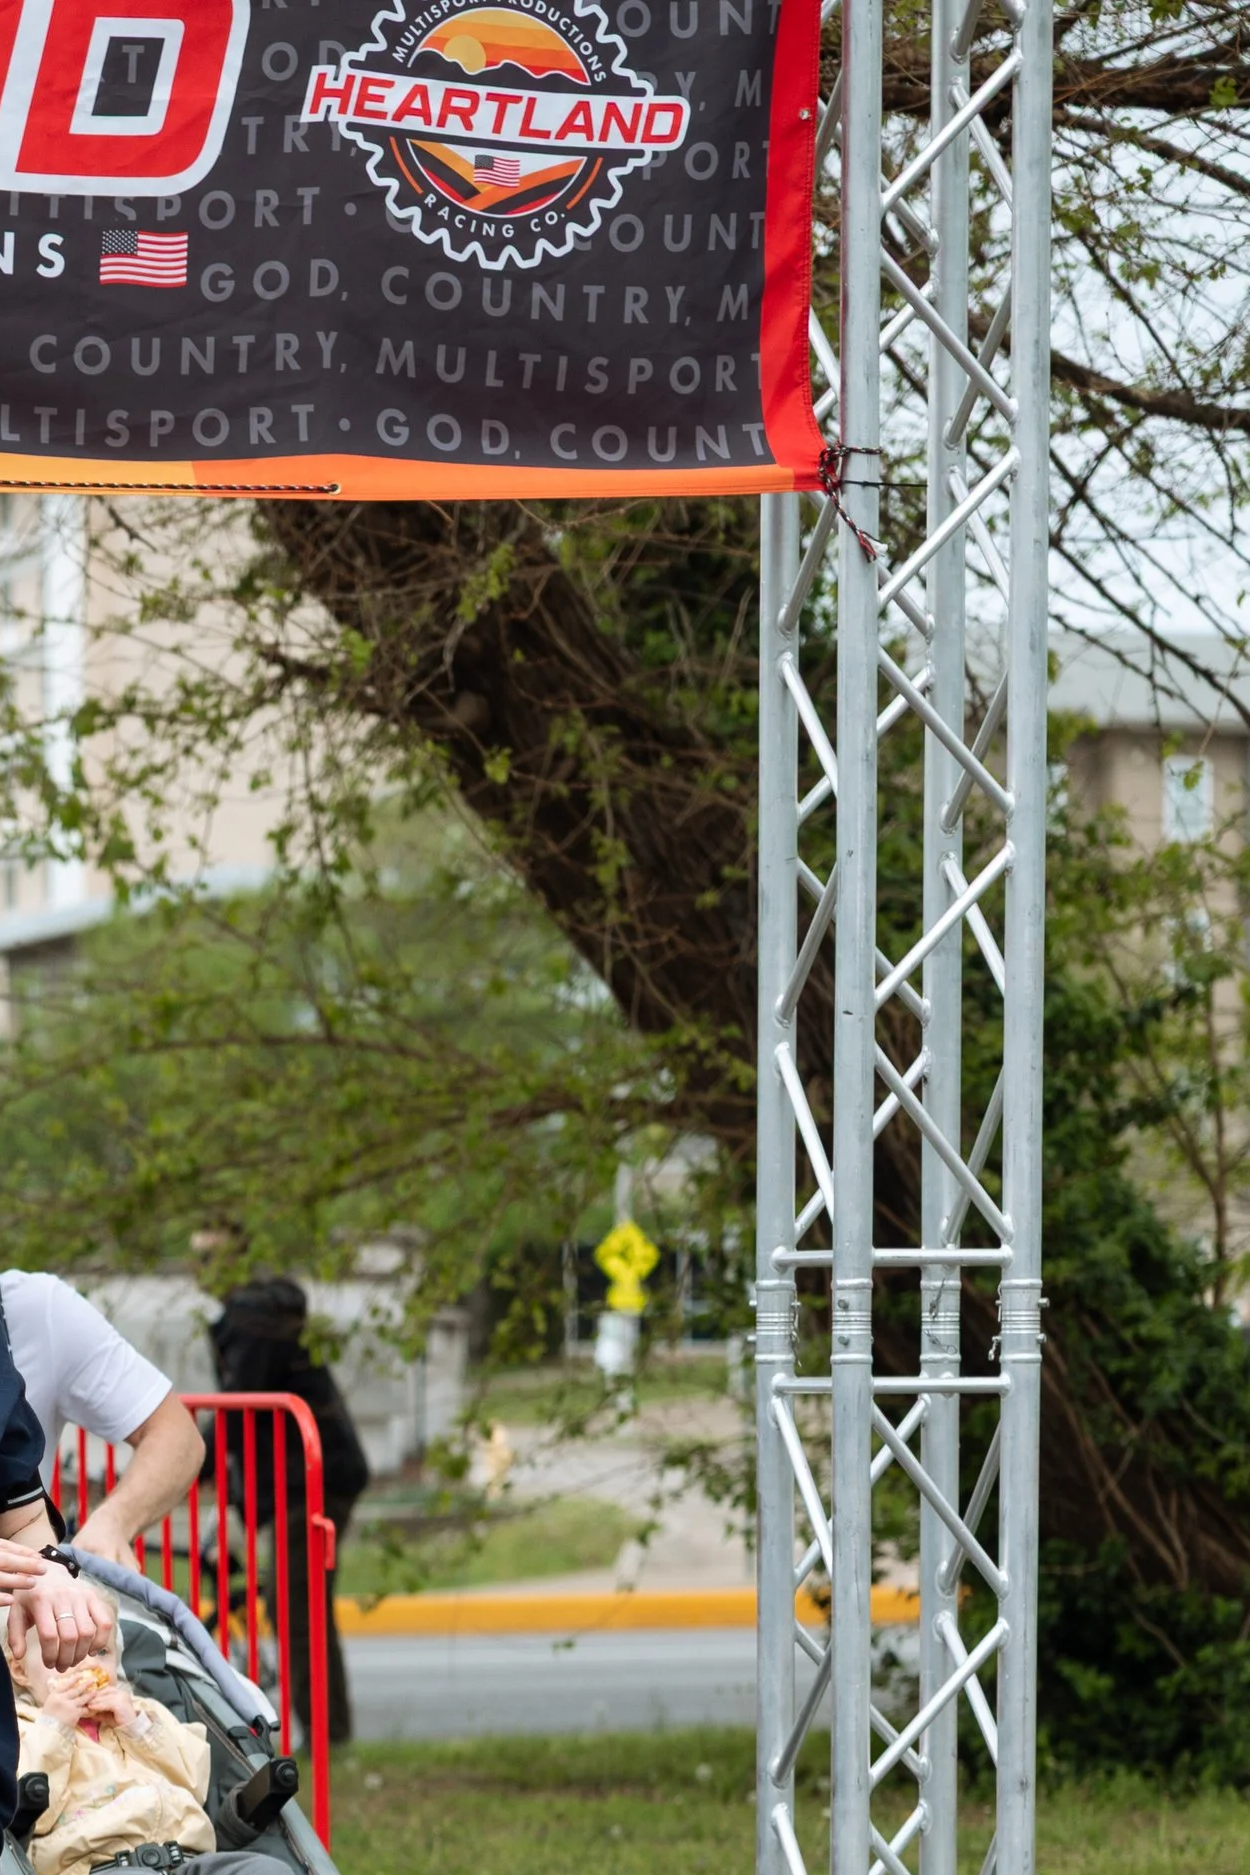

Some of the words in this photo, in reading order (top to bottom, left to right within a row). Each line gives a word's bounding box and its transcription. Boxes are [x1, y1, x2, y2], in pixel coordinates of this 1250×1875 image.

[392, 0, 486, 62] MULTISPO
[497, 0, 607, 83] ODUCTIONS
[308, 72, 684, 144] HEARTLAND
[424, 193, 515, 238] RACING
[530, 211, 566, 232] CO.
[201, 261, 348, 302] GOD,
[381, 265, 692, 326] COUNTRY,
[29, 331, 347, 377] COUNTRY,
[376, 408, 521, 459] GOD,
